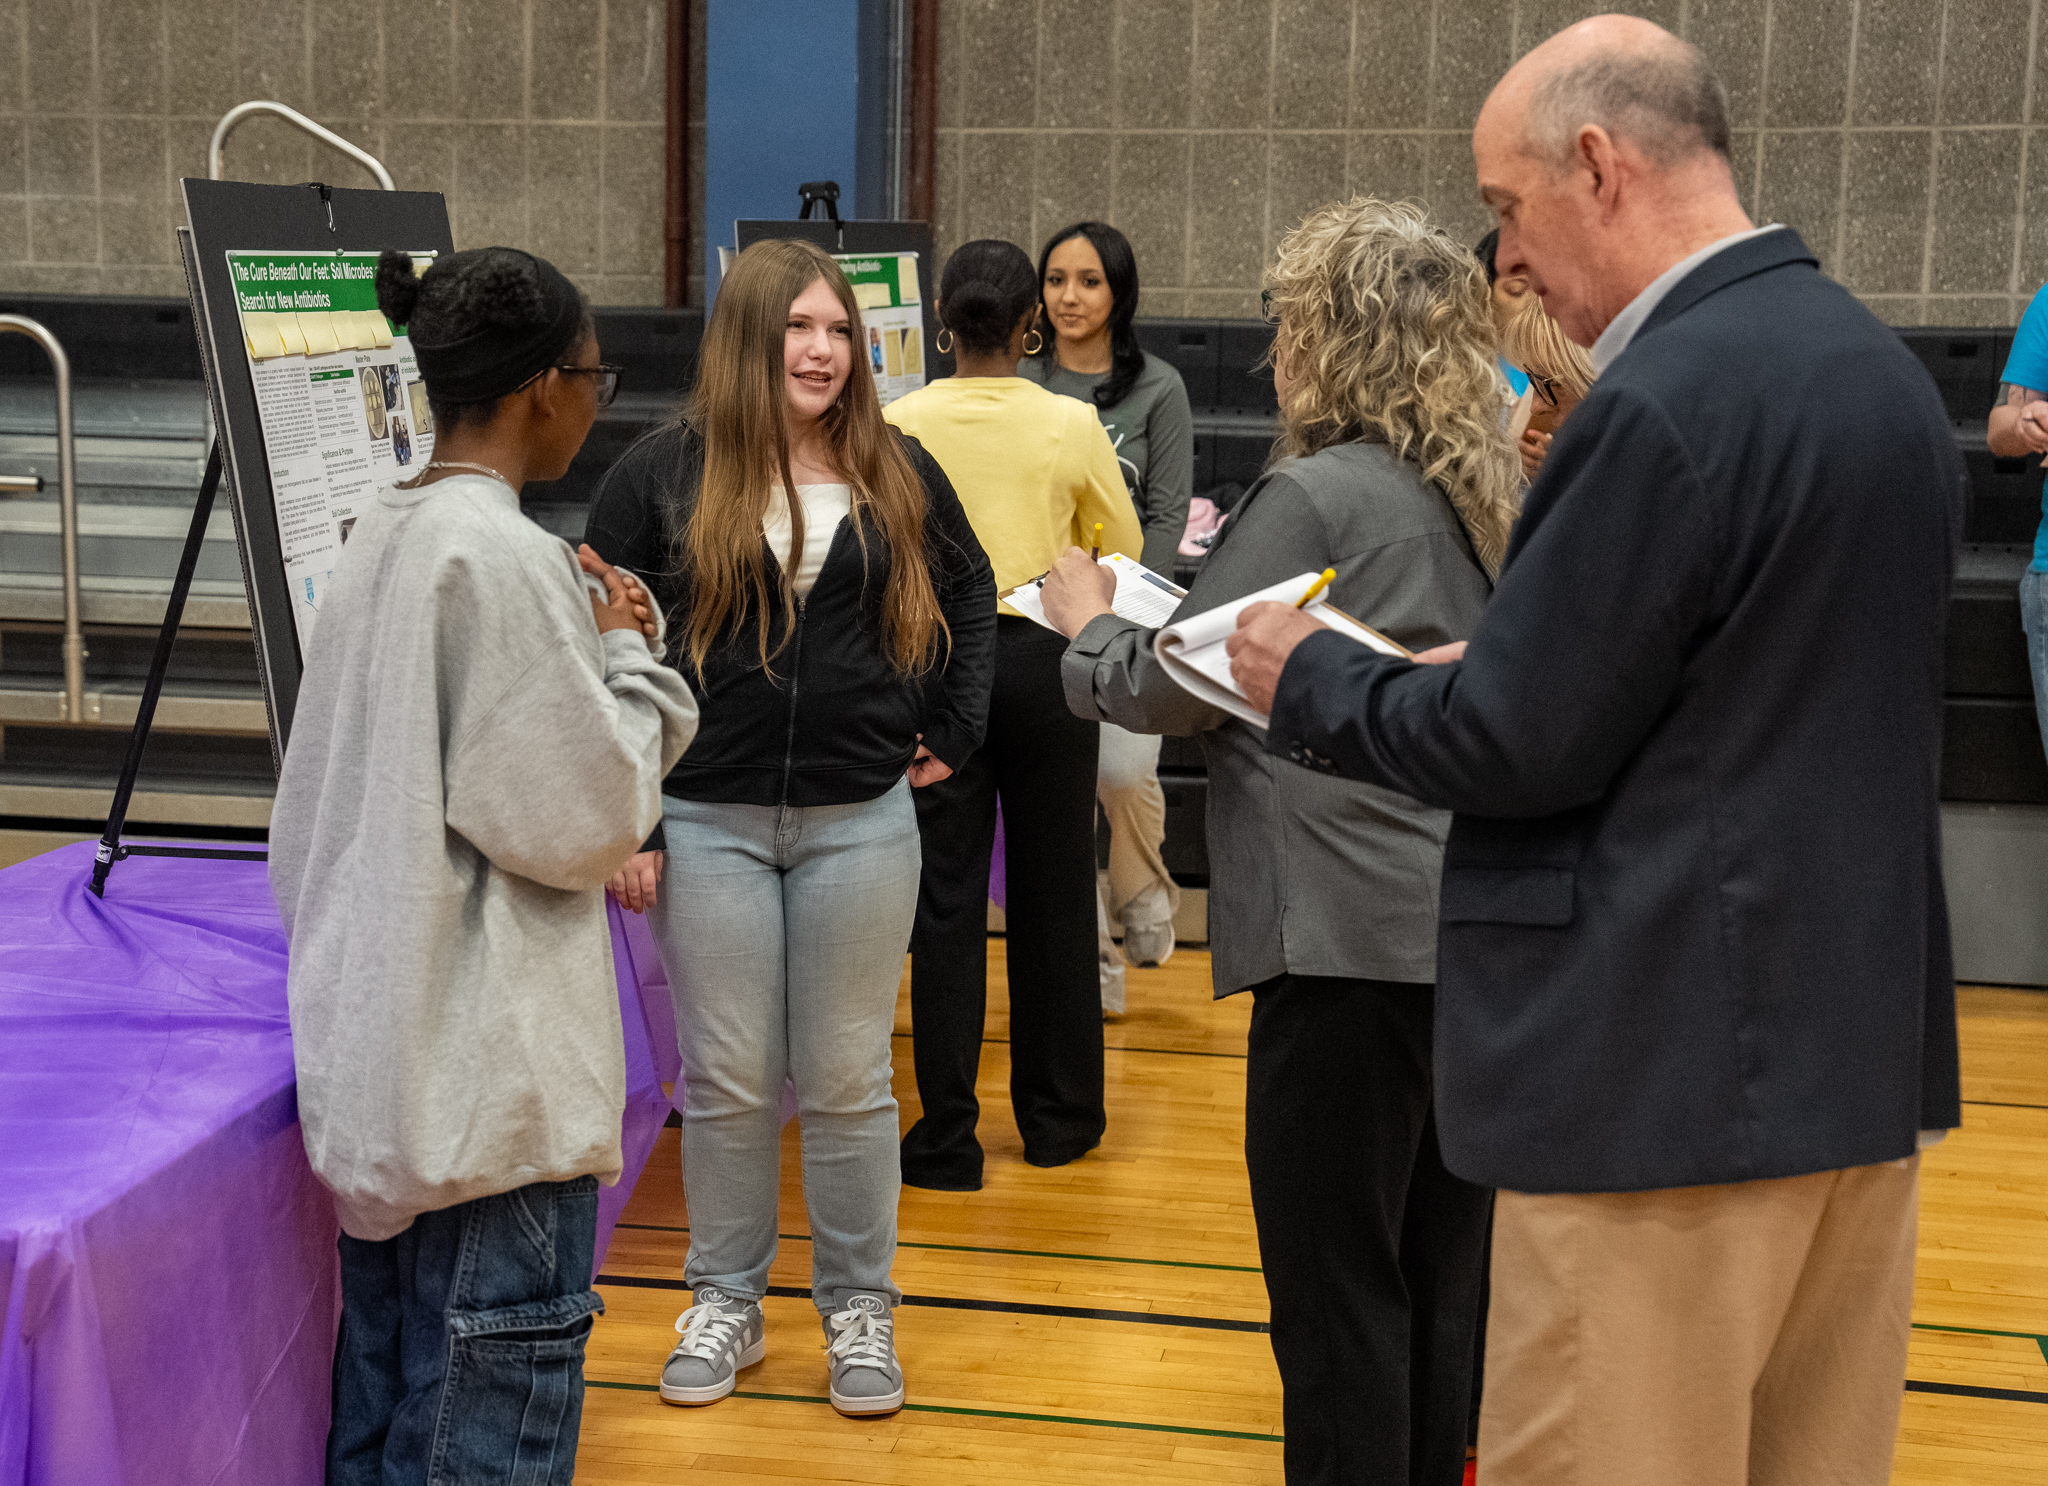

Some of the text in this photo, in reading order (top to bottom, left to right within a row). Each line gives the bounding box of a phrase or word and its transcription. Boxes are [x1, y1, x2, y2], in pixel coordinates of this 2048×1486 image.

[233, 262, 249, 281] The
[249, 262, 268, 281] Cure
[269, 262, 299, 281] Beneath
[299, 262, 312, 280] Our
[313, 261, 330, 280] Feet:
[330, 261, 343, 280] Soil
[342, 261, 374, 280] Microbes
[240, 289, 331, 311] Search for New Antibiotics
